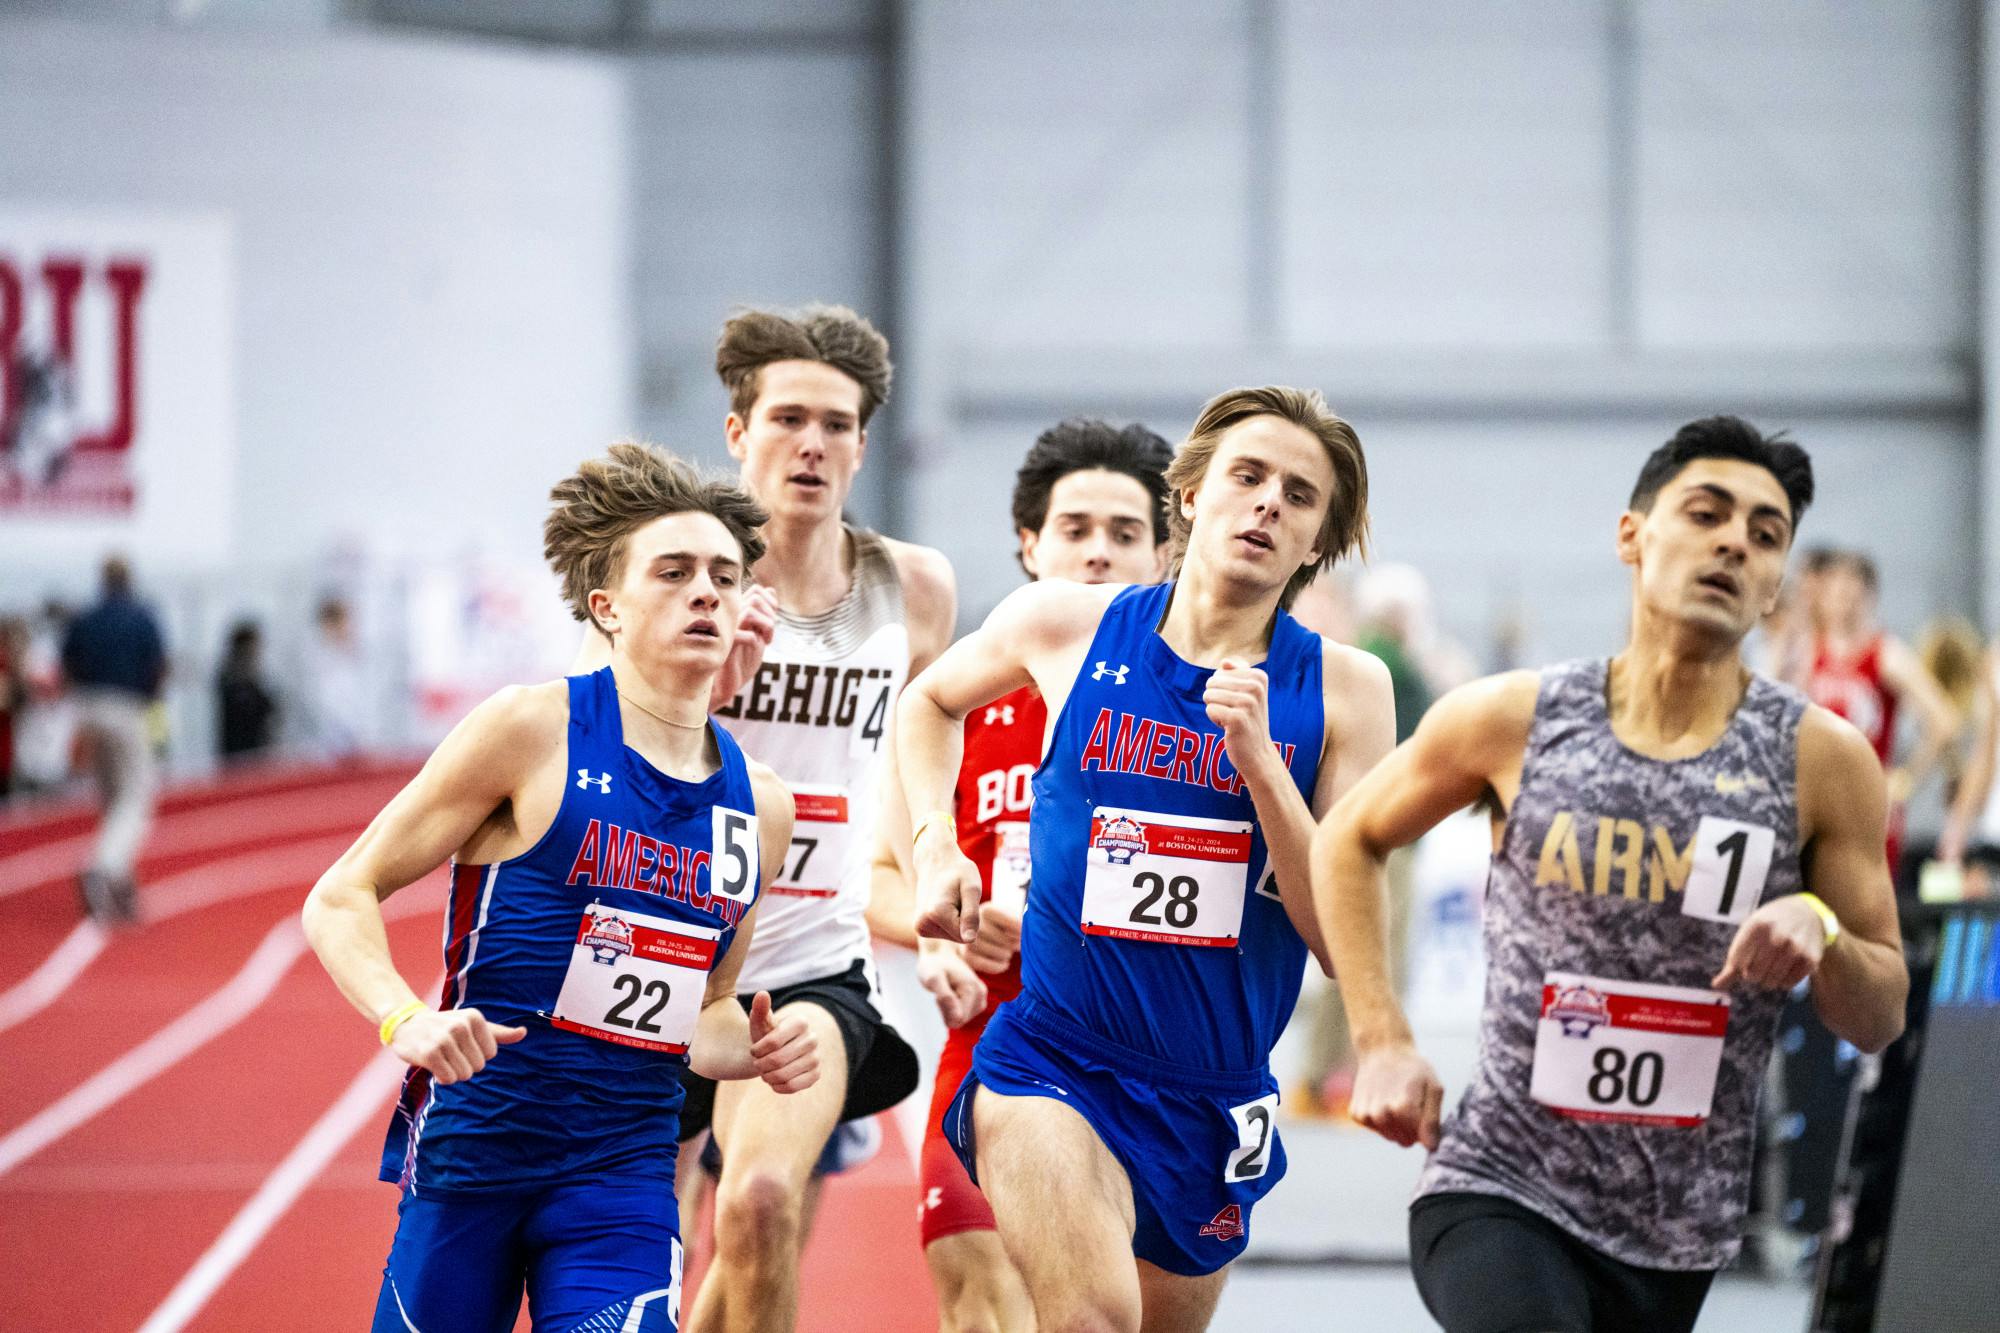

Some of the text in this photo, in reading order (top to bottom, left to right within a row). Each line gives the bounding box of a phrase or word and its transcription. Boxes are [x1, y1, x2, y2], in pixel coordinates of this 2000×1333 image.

[713, 662, 892, 728] EHIG
[861, 685, 890, 752] 4
[976, 763, 1036, 824] BO
[722, 814, 749, 896] 5
[776, 837, 818, 882] 7
[1098, 839, 1144, 852] CHAMPIONSHIPS
[1166, 841, 1196, 851] BOSTON
[1198, 845, 1239, 855] UNIVERSITY
[1535, 811, 1698, 904] ARM
[1716, 830, 1749, 915] 1
[1129, 871, 1199, 929] 28
[649, 945, 675, 956] BOSTON
[675, 950, 708, 962] UNIVERSITY
[603, 974, 671, 1034] 22
[1588, 1047, 1664, 1107] 80
[1234, 1105, 1270, 1177] 2
